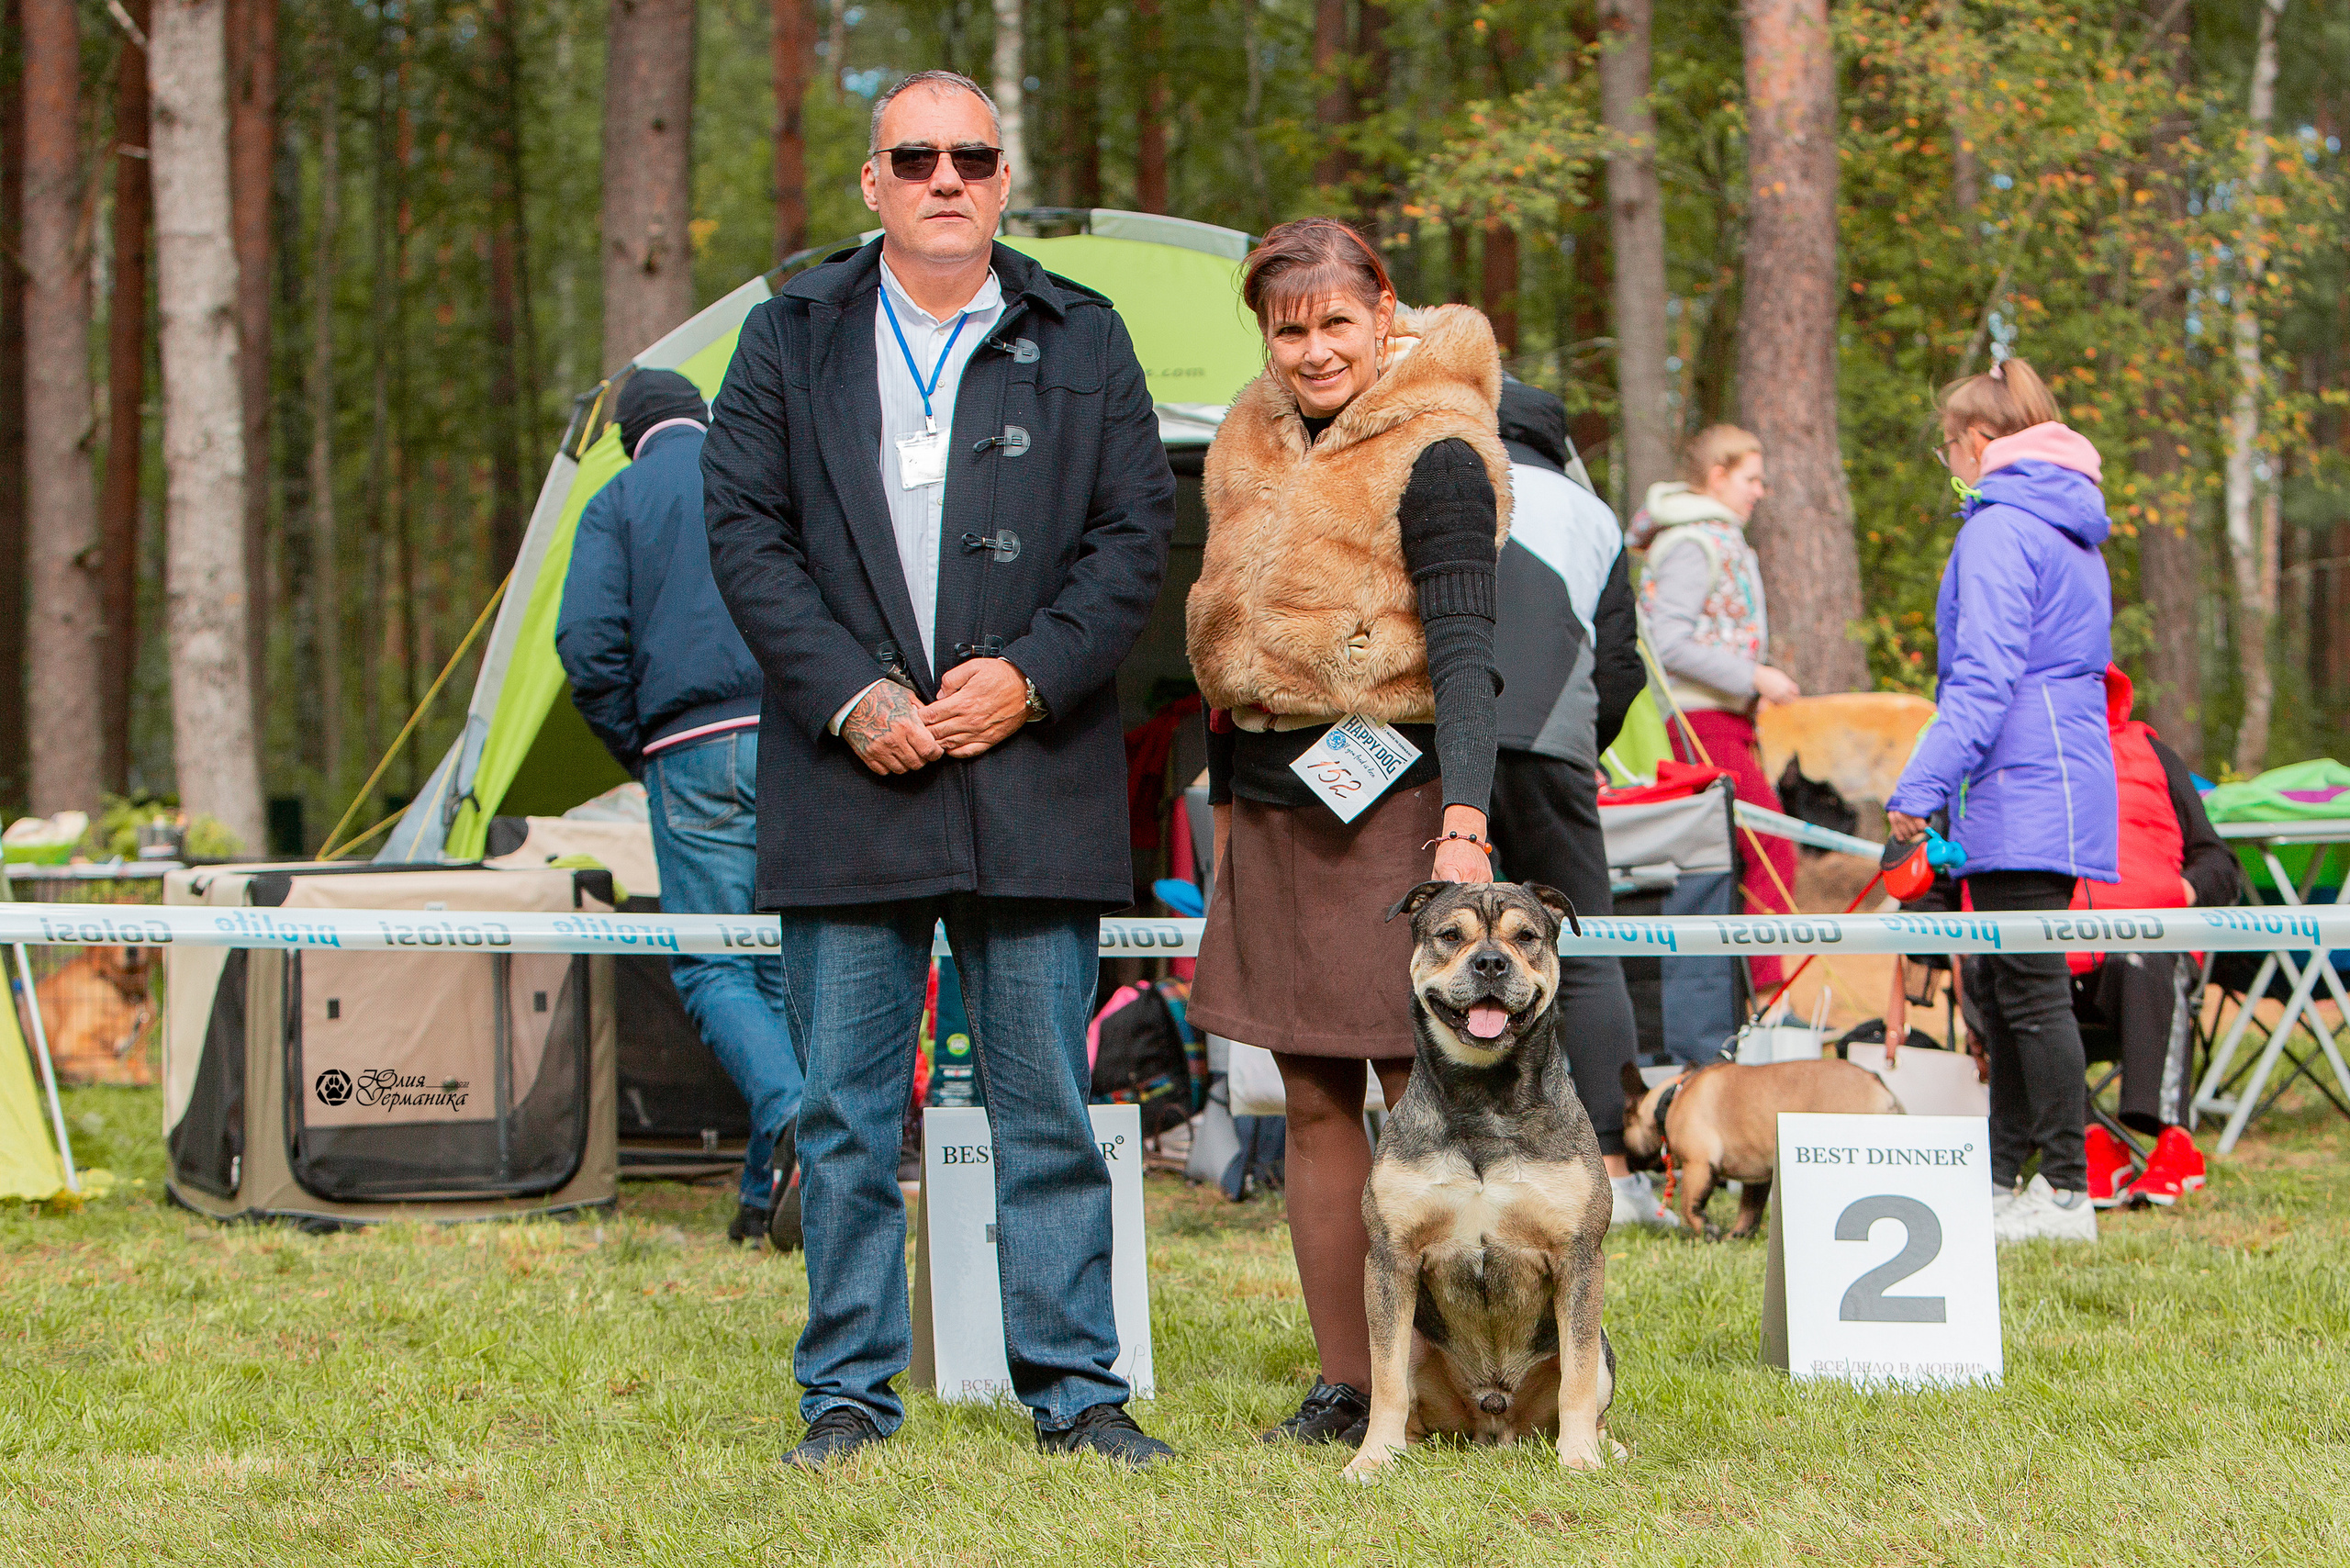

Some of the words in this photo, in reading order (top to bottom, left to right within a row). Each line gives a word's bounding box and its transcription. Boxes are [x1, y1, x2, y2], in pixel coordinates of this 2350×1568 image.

[1342, 714, 1381, 752] HAPPY
[1374, 746, 1402, 775] DOG
[1307, 761, 1361, 799] 152
[942, 1145, 992, 1164] BES
[1795, 1147, 1859, 1164] BEST
[1866, 1148, 1968, 1166] DINNER
[1834, 1193, 1946, 1323] 2
[1813, 1361, 1845, 1372] ВСЕ
[1851, 1361, 1894, 1373] ДЕЛО
[1899, 1362, 1909, 1372] В
[961, 1379, 993, 1391] ВСЕ
